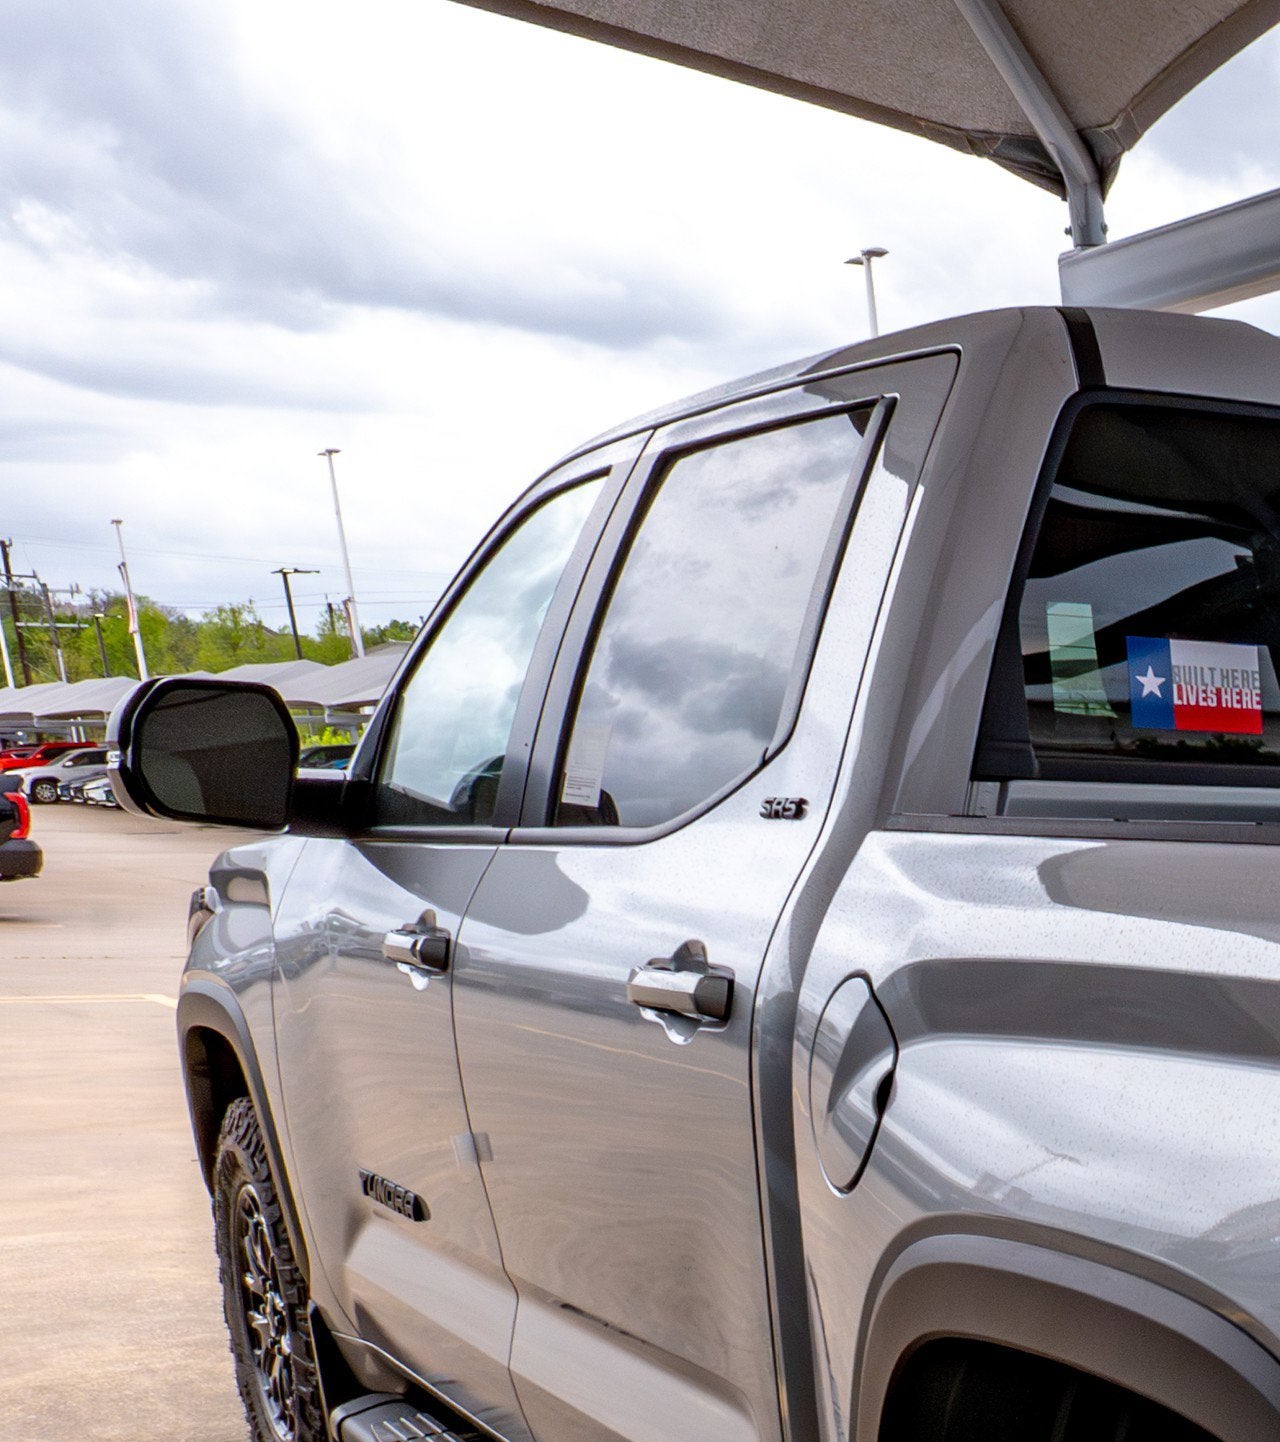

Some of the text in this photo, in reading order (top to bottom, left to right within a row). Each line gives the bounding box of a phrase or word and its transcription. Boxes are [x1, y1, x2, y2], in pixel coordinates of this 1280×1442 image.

[1172, 665, 1261, 690] BUILT HERE
[1173, 684, 1262, 710] LIVES HERE
[760, 797, 803, 820] SR5
[358, 1168, 417, 1221] TUNDRA
